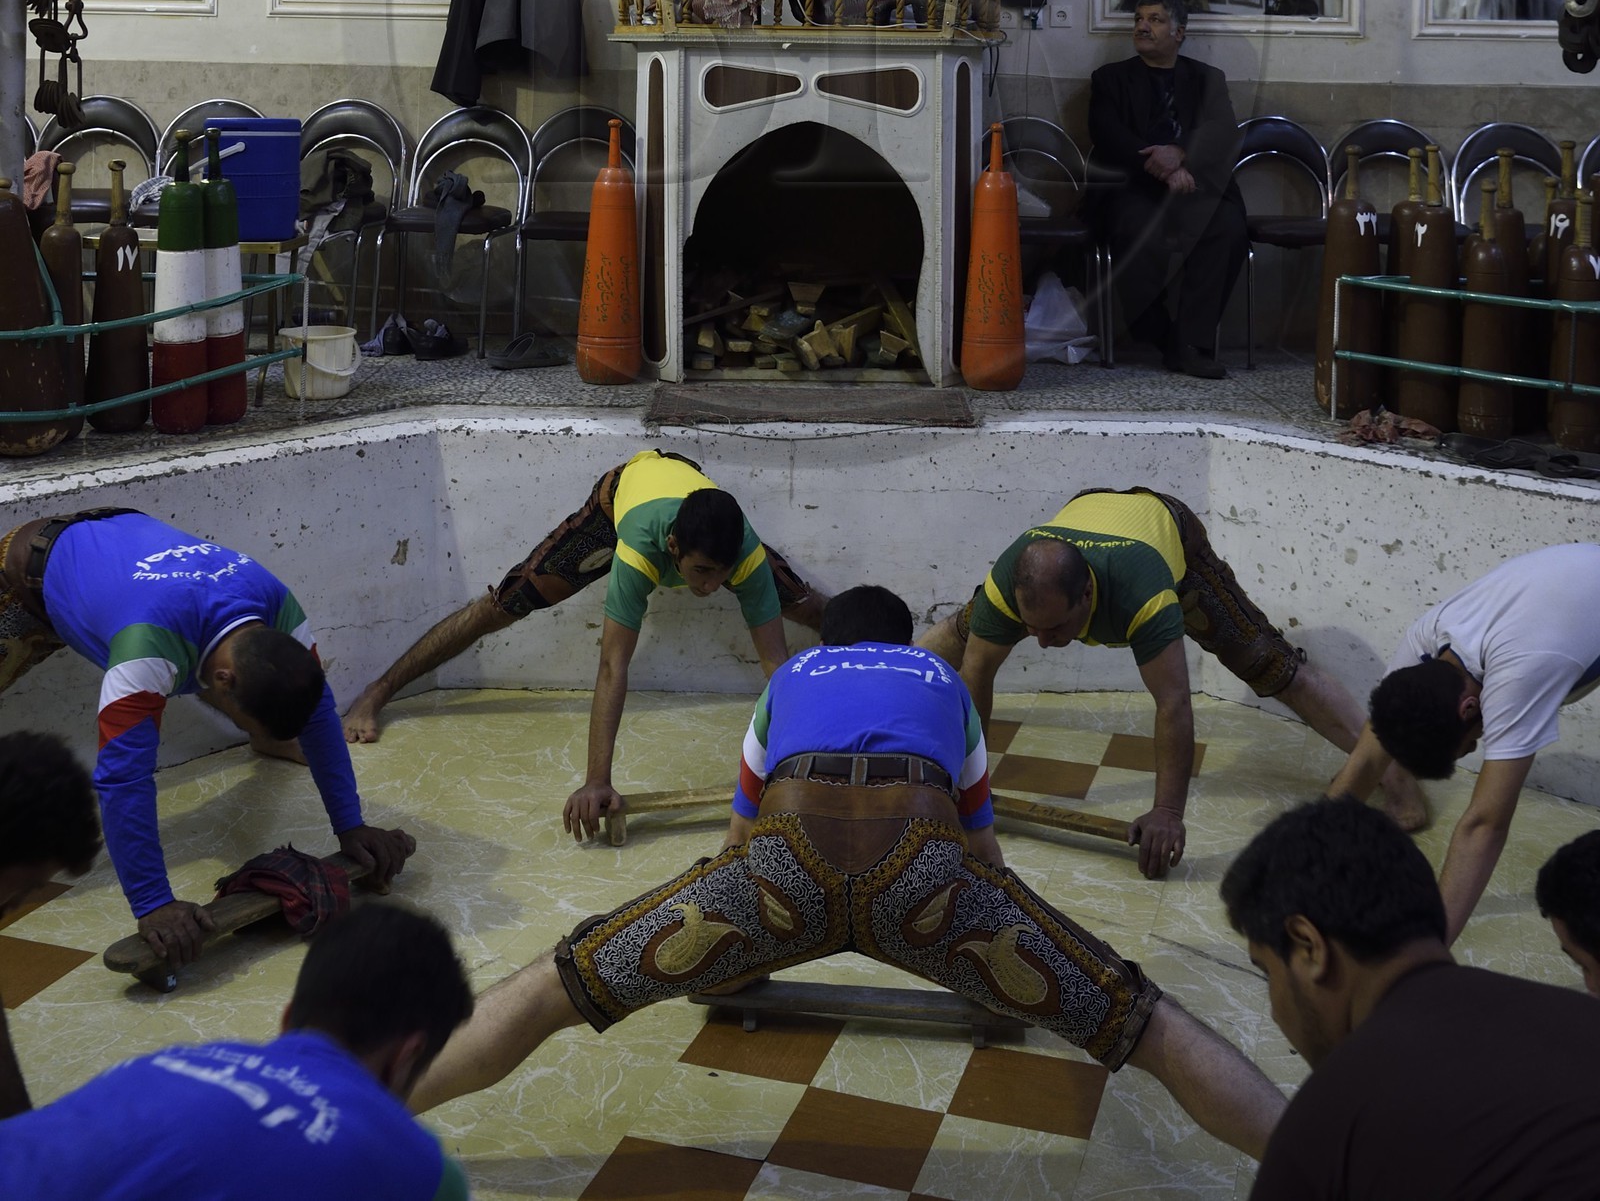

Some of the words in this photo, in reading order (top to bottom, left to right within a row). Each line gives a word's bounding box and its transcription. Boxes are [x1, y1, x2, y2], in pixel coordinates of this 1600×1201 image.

[116, 244, 138, 272] ۱۷
[136, 543, 221, 571] اصفهان
[809, 661, 935, 684] اصفهان
